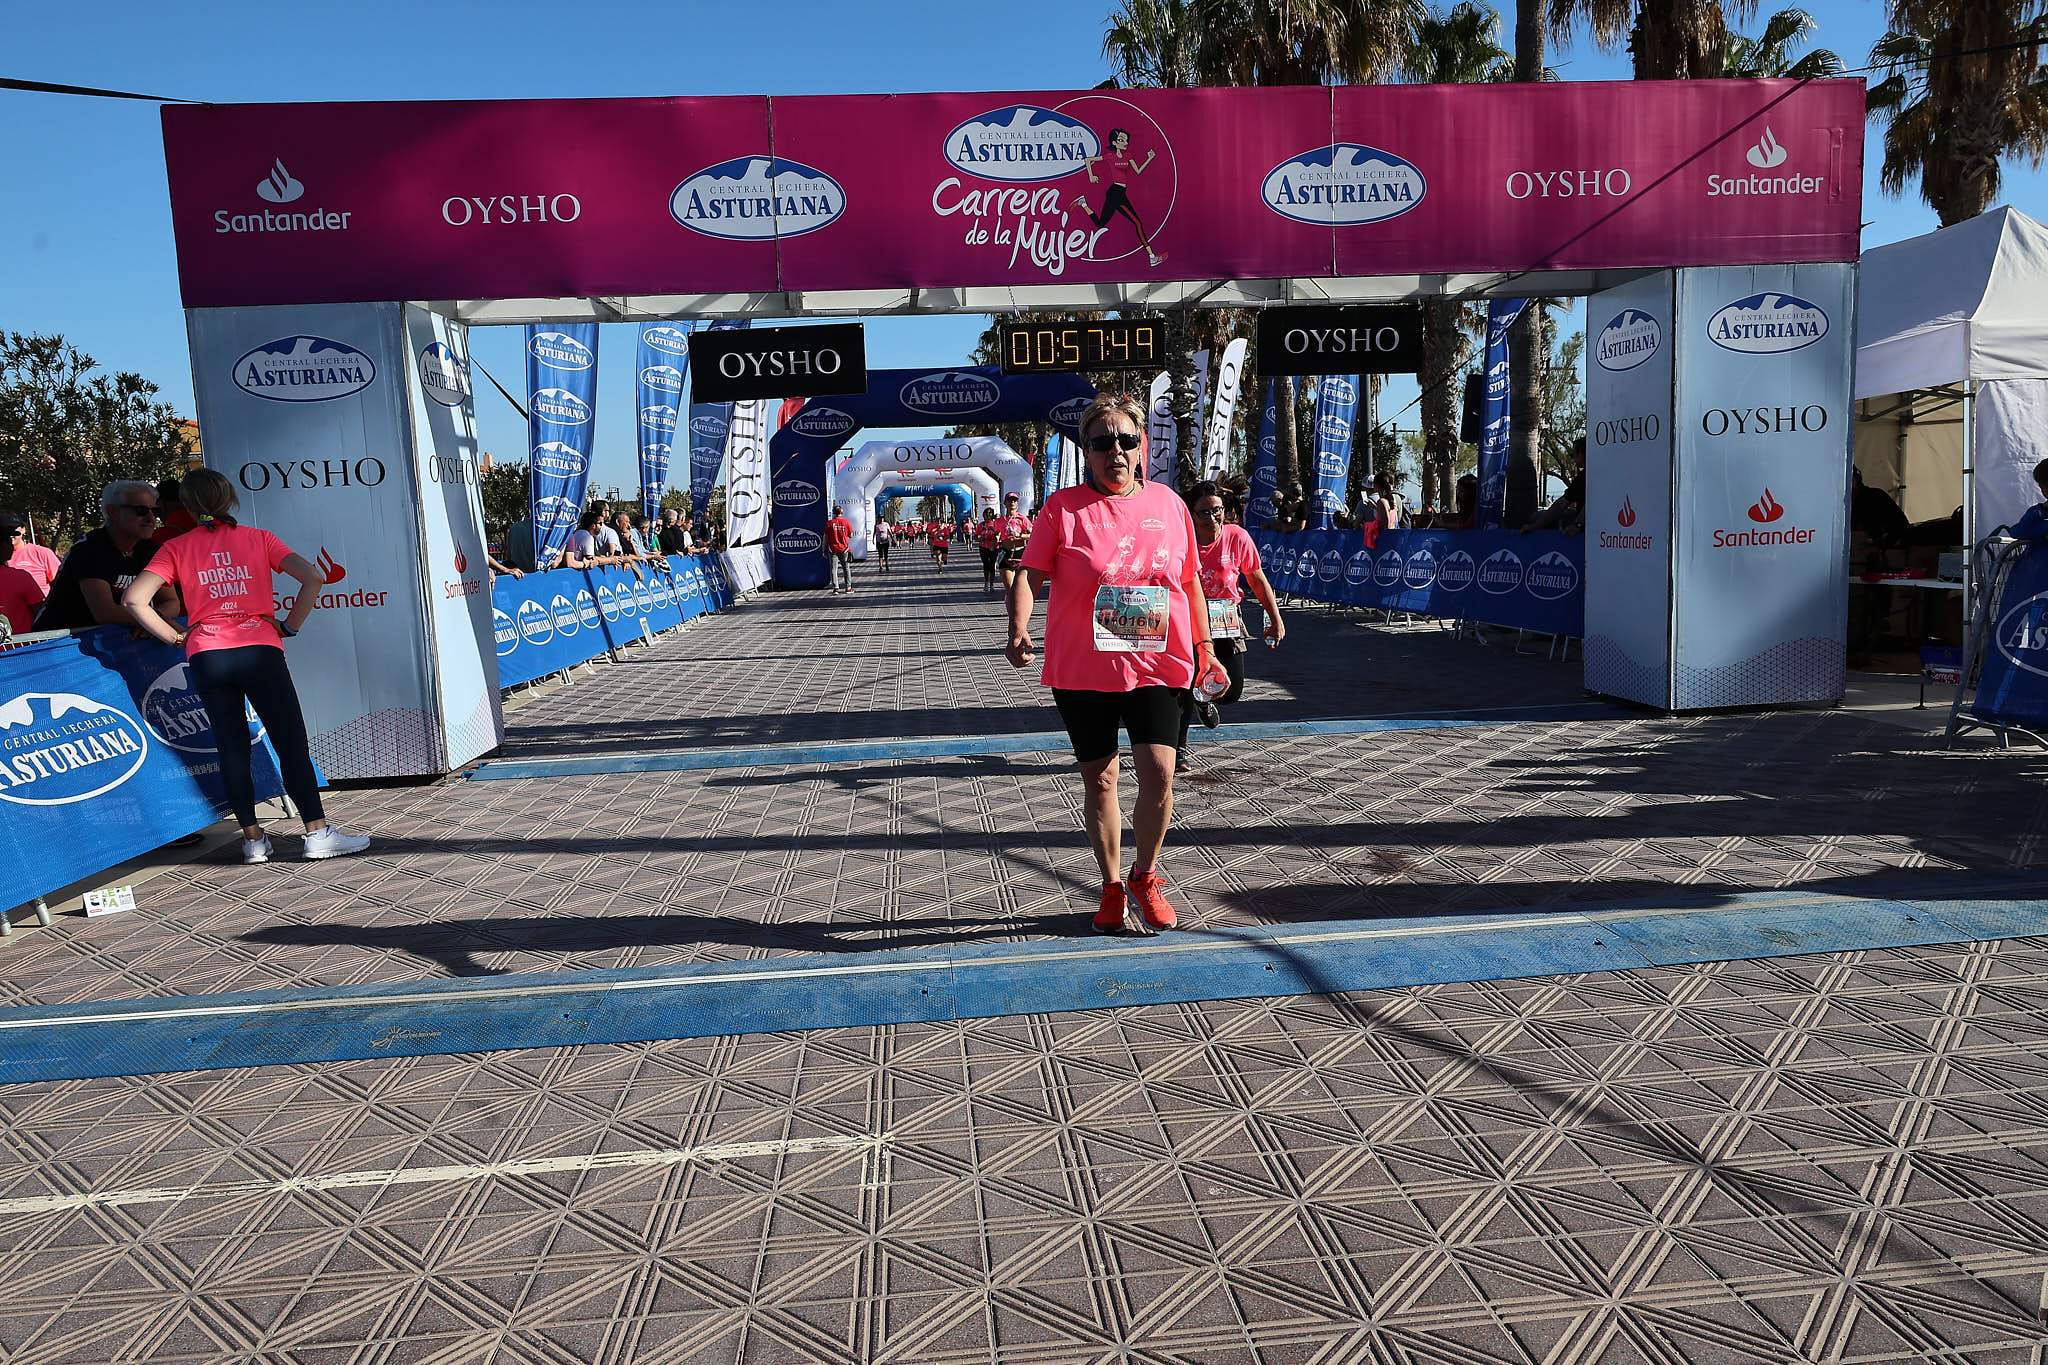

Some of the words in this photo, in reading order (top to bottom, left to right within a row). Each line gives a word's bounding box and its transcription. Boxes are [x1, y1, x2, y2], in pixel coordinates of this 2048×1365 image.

[979, 131, 1030, 140] CENTRAL
[1032, 130, 1084, 139] LECHERA
[956, 134, 1088, 162] ASTURIANA
[1299, 172, 1351, 181] CENTRAL
[1355, 170, 1409, 179] LECHERA
[1505, 168, 1632, 199] OYSHO
[1707, 172, 1825, 196] Santander
[709, 184, 765, 194] CENTRAL
[769, 182, 827, 193] LECHERA
[932, 177, 1061, 216] Carrera
[1274, 174, 1415, 205] ASTURIANA
[441, 193, 582, 226] OYSHO
[684, 188, 833, 220] ASTURIANA
[214, 208, 352, 233] Santander
[965, 218, 989, 245] de
[994, 216, 1012, 245] la
[1007, 211, 1109, 276] Mujer
[1715, 316, 1820, 340] ASTURIANA
[1734, 312, 1773, 322] CENTRAL
[1776, 311, 1817, 320] LECHERA
[647, 333, 687, 352] ASTURIAN
[1012, 327, 1153, 365] 00:57:49
[1284, 326, 1400, 354] OYSHO
[1600, 333, 1656, 360] ASTURIANA
[264, 359, 311, 367] CENTRAL
[313, 357, 360, 365] LECHERA
[534, 339, 588, 366] ASTURIANA
[719, 349, 841, 378] OYSHO
[244, 361, 367, 387] ASTURIANA
[423, 361, 467, 394] ASTURIANA
[907, 386, 994, 405] ASTURIANA
[534, 396, 586, 420] ASTURIANA
[1702, 404, 1828, 436] OYSHO
[795, 418, 850, 431] ASTURIANA
[1595, 413, 1660, 446] OYSHO
[893, 443, 973, 463] OYSHO
[239, 457, 386, 491] OYSHO
[429, 455, 475, 486] OYSHO
[774, 489, 817, 501] ASTURIANA
[776, 537, 818, 548] ASTURIANA
[1600, 531, 1652, 550] Santander
[1712, 526, 1816, 548] Santander
[211, 551, 232, 567] TU
[197, 565, 253, 586] DORSAL
[1479, 565, 1519, 584] ASTURIANA
[1528, 565, 1571, 590] ASTURIANA
[208, 581, 248, 599] SUMA
[272, 588, 388, 612] Satander
[444, 578, 481, 600] Santander
[220, 601, 238, 610] 2024
[4, 728, 61, 750] CENTRAL
[61, 714, 117, 735] LECHERA
